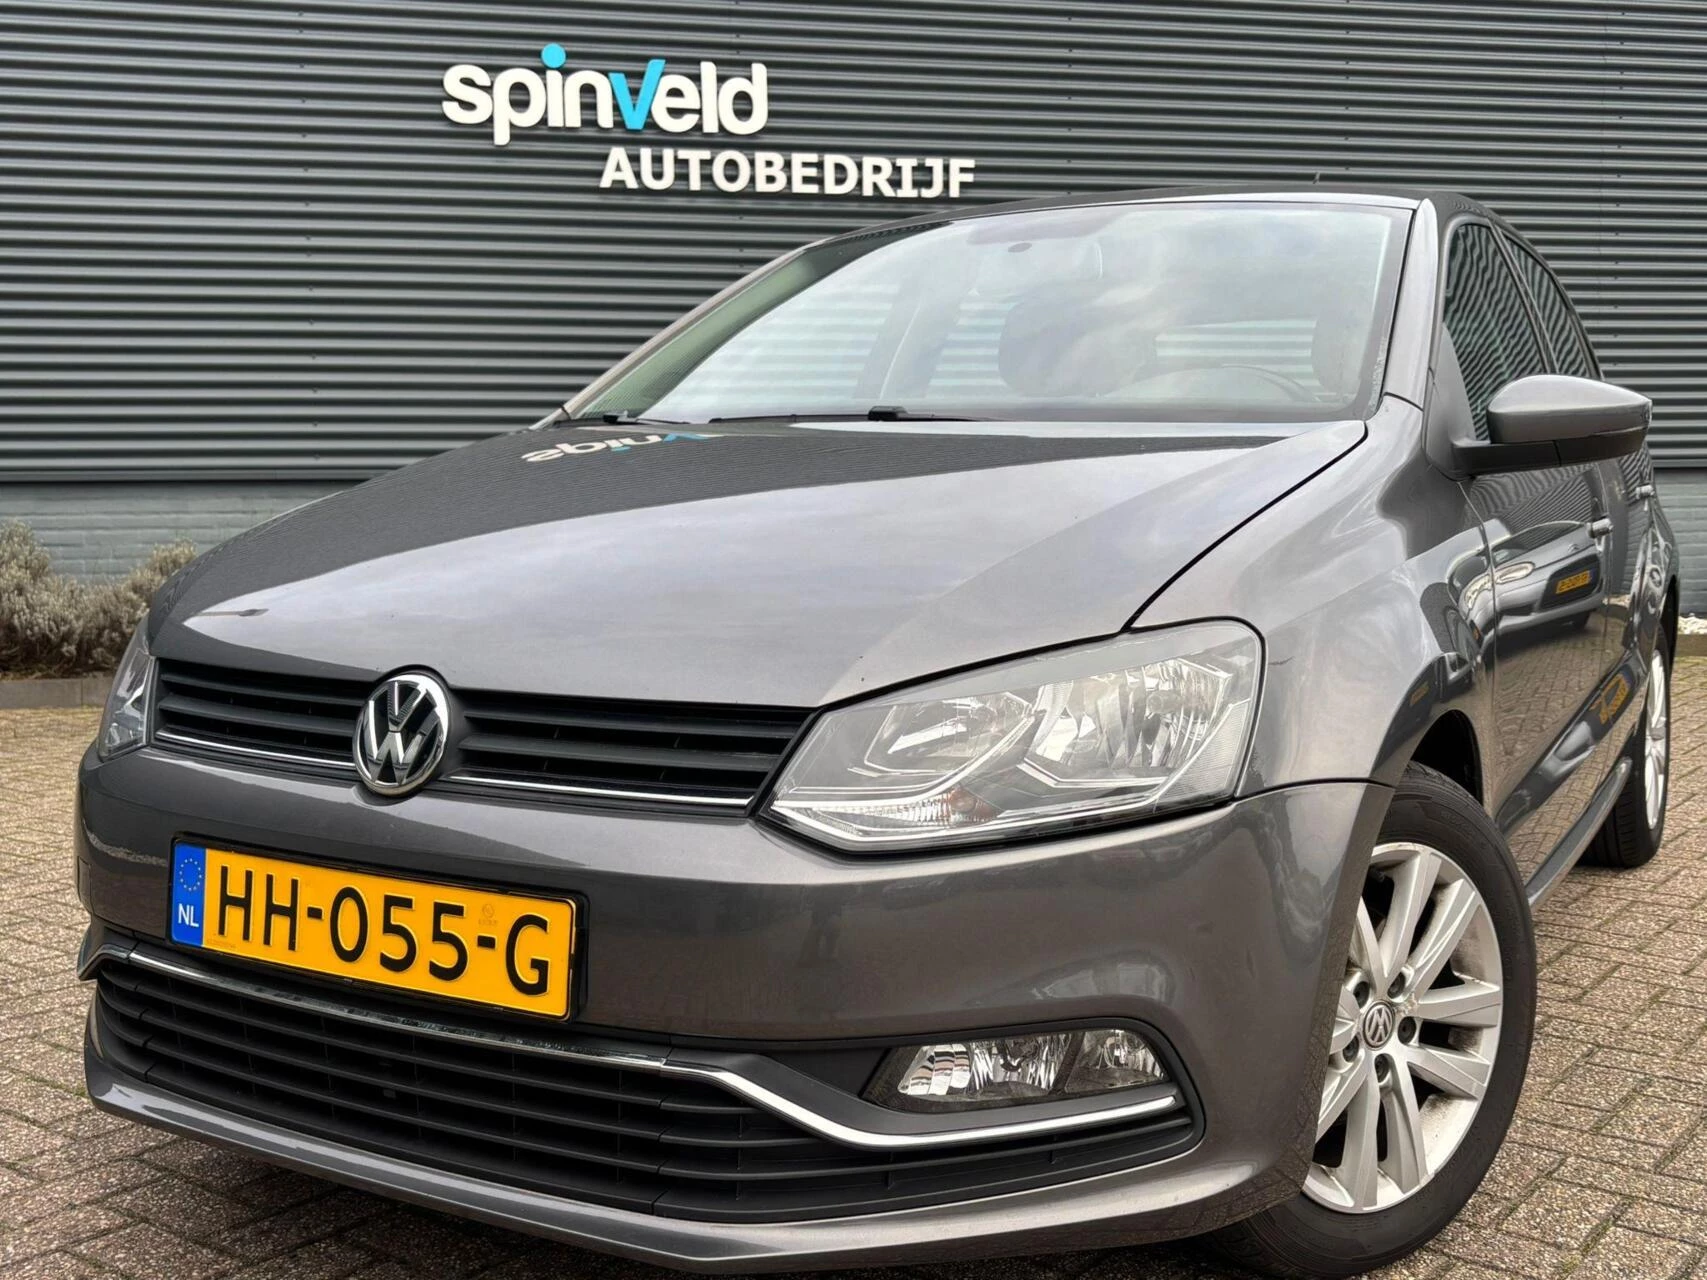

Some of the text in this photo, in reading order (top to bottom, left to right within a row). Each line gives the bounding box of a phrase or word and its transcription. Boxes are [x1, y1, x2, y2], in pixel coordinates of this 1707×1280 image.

[600, 146, 976, 198] AUTOBEDRIJF
[178, 903, 200, 928] NL
[217, 865, 550, 996] HH-055-G
